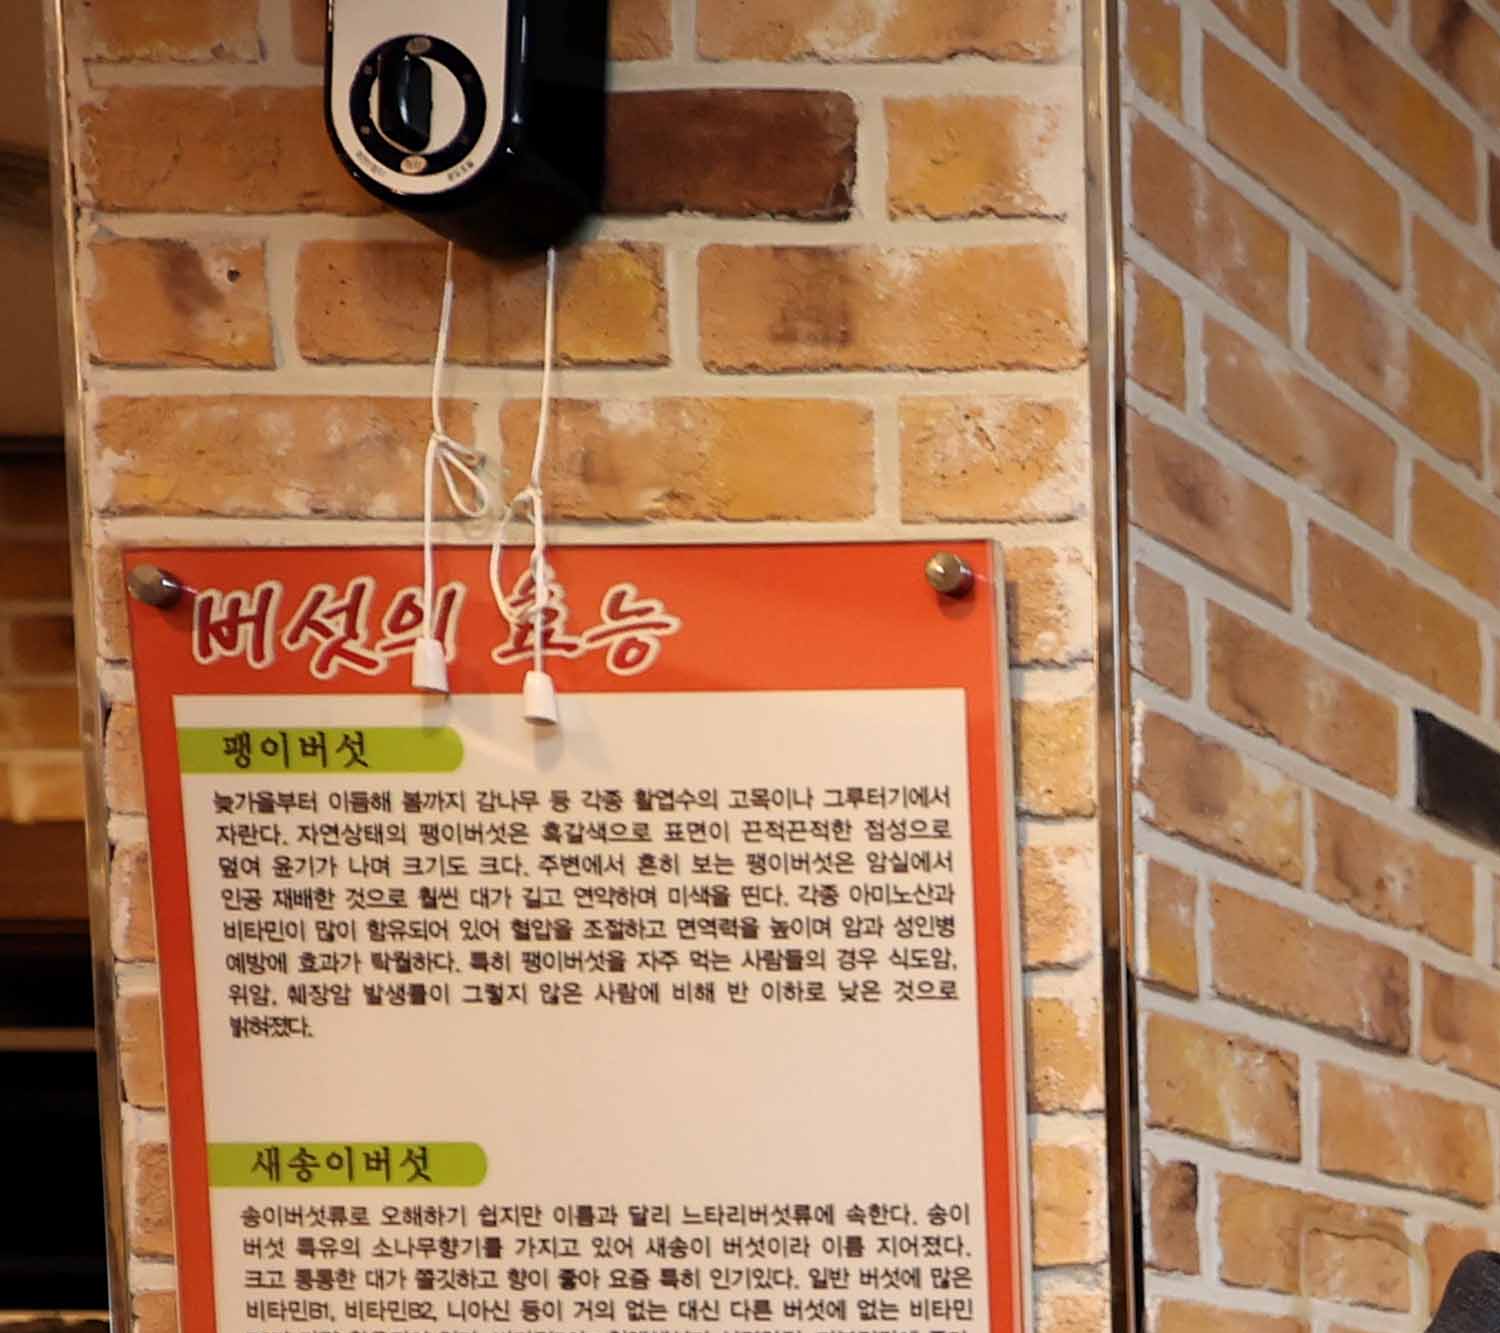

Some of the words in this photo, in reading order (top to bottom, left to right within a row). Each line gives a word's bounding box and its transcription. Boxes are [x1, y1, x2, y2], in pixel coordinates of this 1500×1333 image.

[193, 577, 466, 680] 버섯의
[223, 730, 369, 769] 팽이버섯
[475, 789, 541, 814] 감나무
[581, 788, 625, 815] 각종
[728, 786, 814, 811] 고목이나
[822, 784, 951, 810] 그루터기에서
[296, 821, 408, 848] 자연상태의
[418, 821, 531, 847] 팽이버섯은
[664, 819, 731, 844] 표면이
[864, 817, 952, 843] 점성으로
[348, 854, 392, 878] 나며
[402, 853, 469, 878] 크기도
[536, 852, 626, 878] 주변에서
[691, 852, 736, 876] 보는
[745, 850, 856, 876] 팽이버섯은
[220, 888, 264, 912] 인공
[344, 886, 410, 912] 것으로
[573, 884, 658, 910] 연약하며
[849, 881, 956, 906] 아미노산과
[223, 918, 307, 944] 비타민이
[314, 918, 358, 944] 많이
[841, 914, 885, 939] 암과
[893, 914, 956, 939] 성인병
[225, 950, 289, 976] 예방에
[297, 950, 363, 975] 효과가
[520, 949, 628, 974] 팽이버섯을
[836, 947, 880, 972] 경우
[594, 981, 661, 1005] 사람에
[672, 980, 716, 1005] 비해
[761, 980, 828, 1004] 이하로
[893, 979, 960, 1003] 것으로
[251, 1145, 433, 1183] 새송이버섯
[240, 1204, 372, 1229] 송이버섯류로
[379, 1204, 468, 1228] 오해하기
[552, 1204, 619, 1228] 이름과
[680, 1203, 836, 1228] 느타리버섯류에
[926, 1202, 970, 1227] 송이
[243, 1236, 286, 1260] 버섯
[514, 1235, 582, 1260] 가지고
[591, 1234, 635, 1259] 있어
[645, 1235, 712, 1260] 새송이
[722, 1234, 813, 1259] 버섯이라
[821, 1235, 866, 1259] 이름
[244, 1269, 287, 1289] 크고
[365, 1267, 408, 1291] 대가
[506, 1267, 550, 1292] 향이
[808, 1266, 852, 1290] 일반
[858, 1266, 922, 1290] 버섯에
[930, 1266, 973, 1290] 많은
[447, 1298, 512, 1323] 니아신
[573, 1298, 616, 1322] 거의
[624, 1298, 670, 1322] 없는
[730, 1298, 774, 1322] 다른
[783, 1298, 848, 1323] 버섯에
[856, 1298, 901, 1322] 없는
[909, 1297, 974, 1322] 비타민
